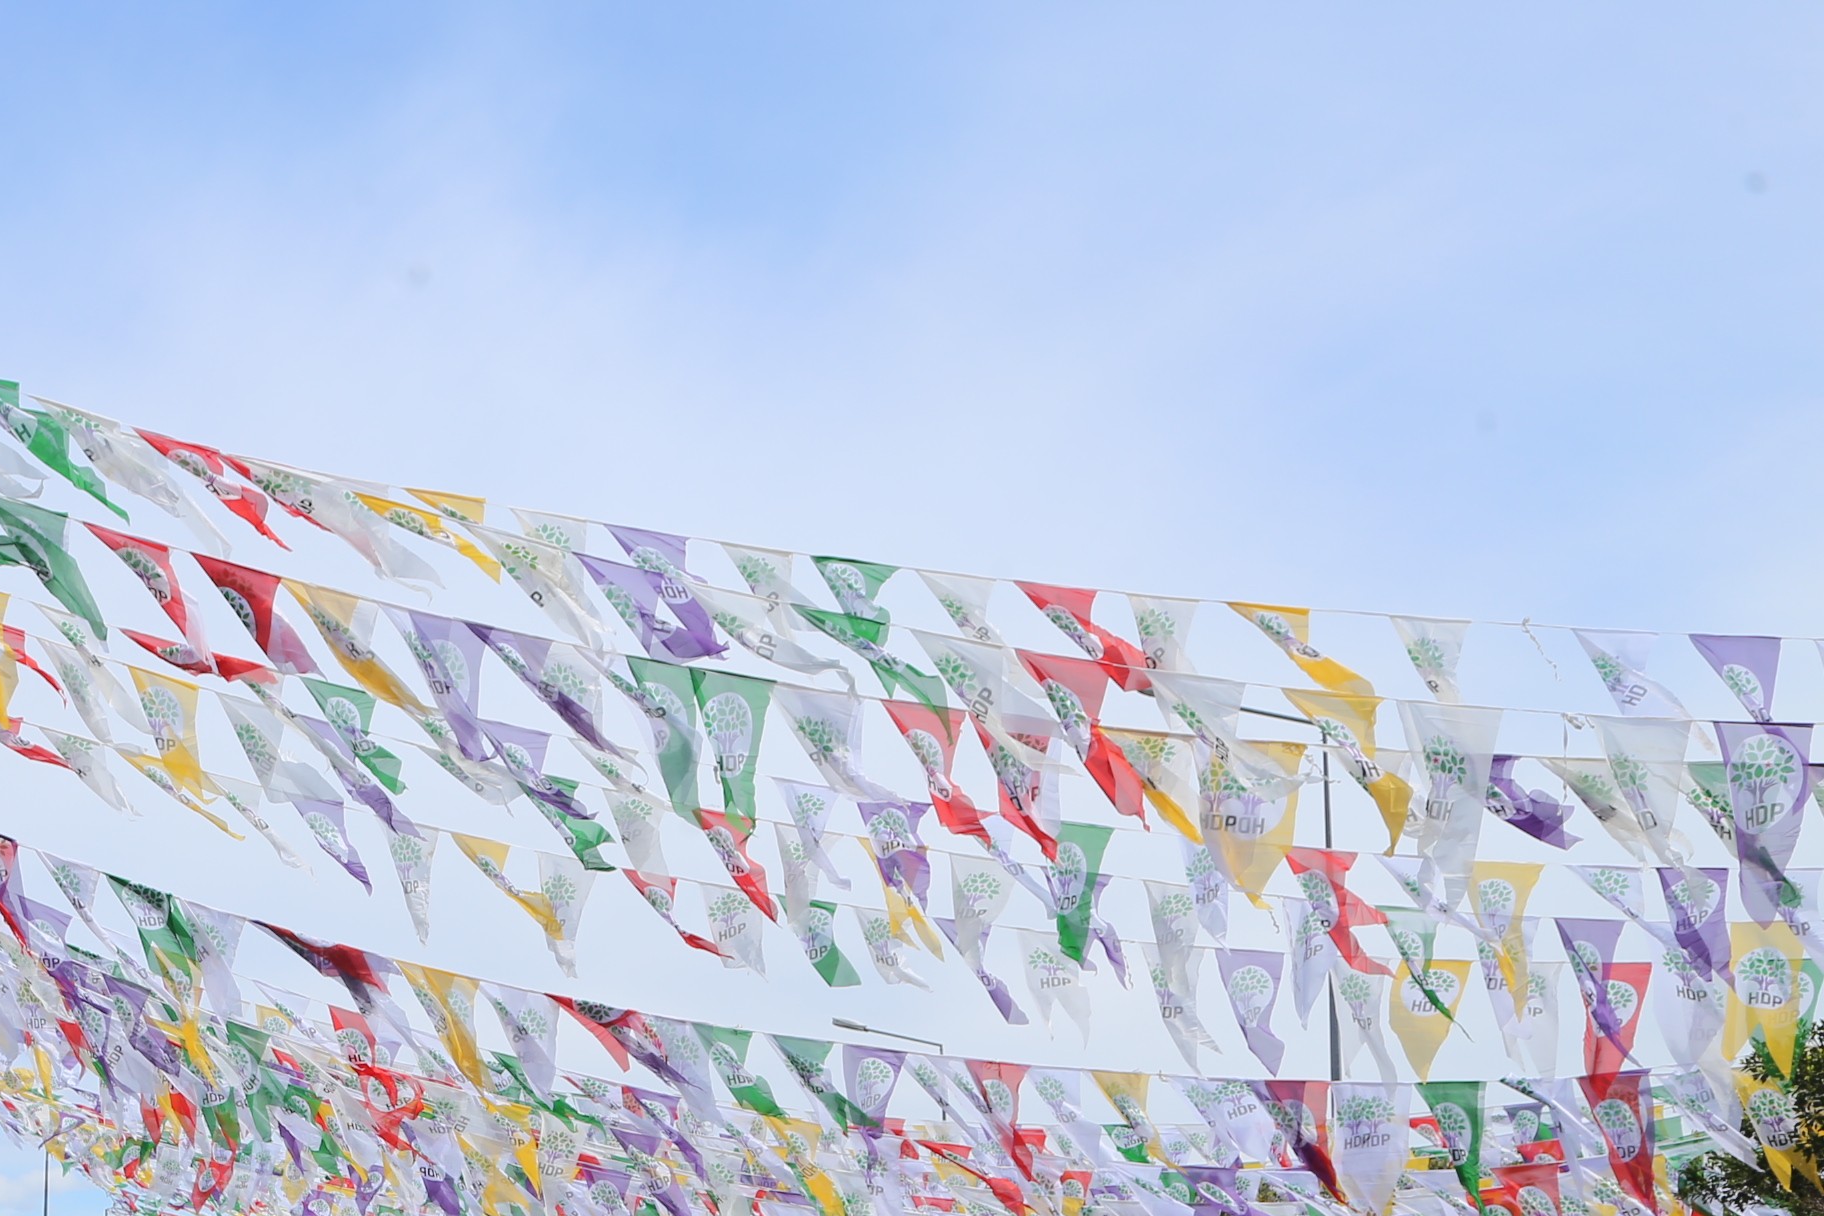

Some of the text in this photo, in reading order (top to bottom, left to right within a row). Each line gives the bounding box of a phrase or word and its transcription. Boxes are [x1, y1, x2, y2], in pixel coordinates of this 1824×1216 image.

[156, 736, 177, 751] DP
[1745, 803, 1784, 831] HDP
[138, 915, 165, 927] HDP
[957, 907, 988, 921] HDP
[719, 923, 748, 942] HDP
[1040, 975, 1072, 989] HDP
[1676, 986, 1708, 1002] HDP
[1748, 993, 1783, 1007] HDP
[1227, 1104, 1257, 1120] HDP
